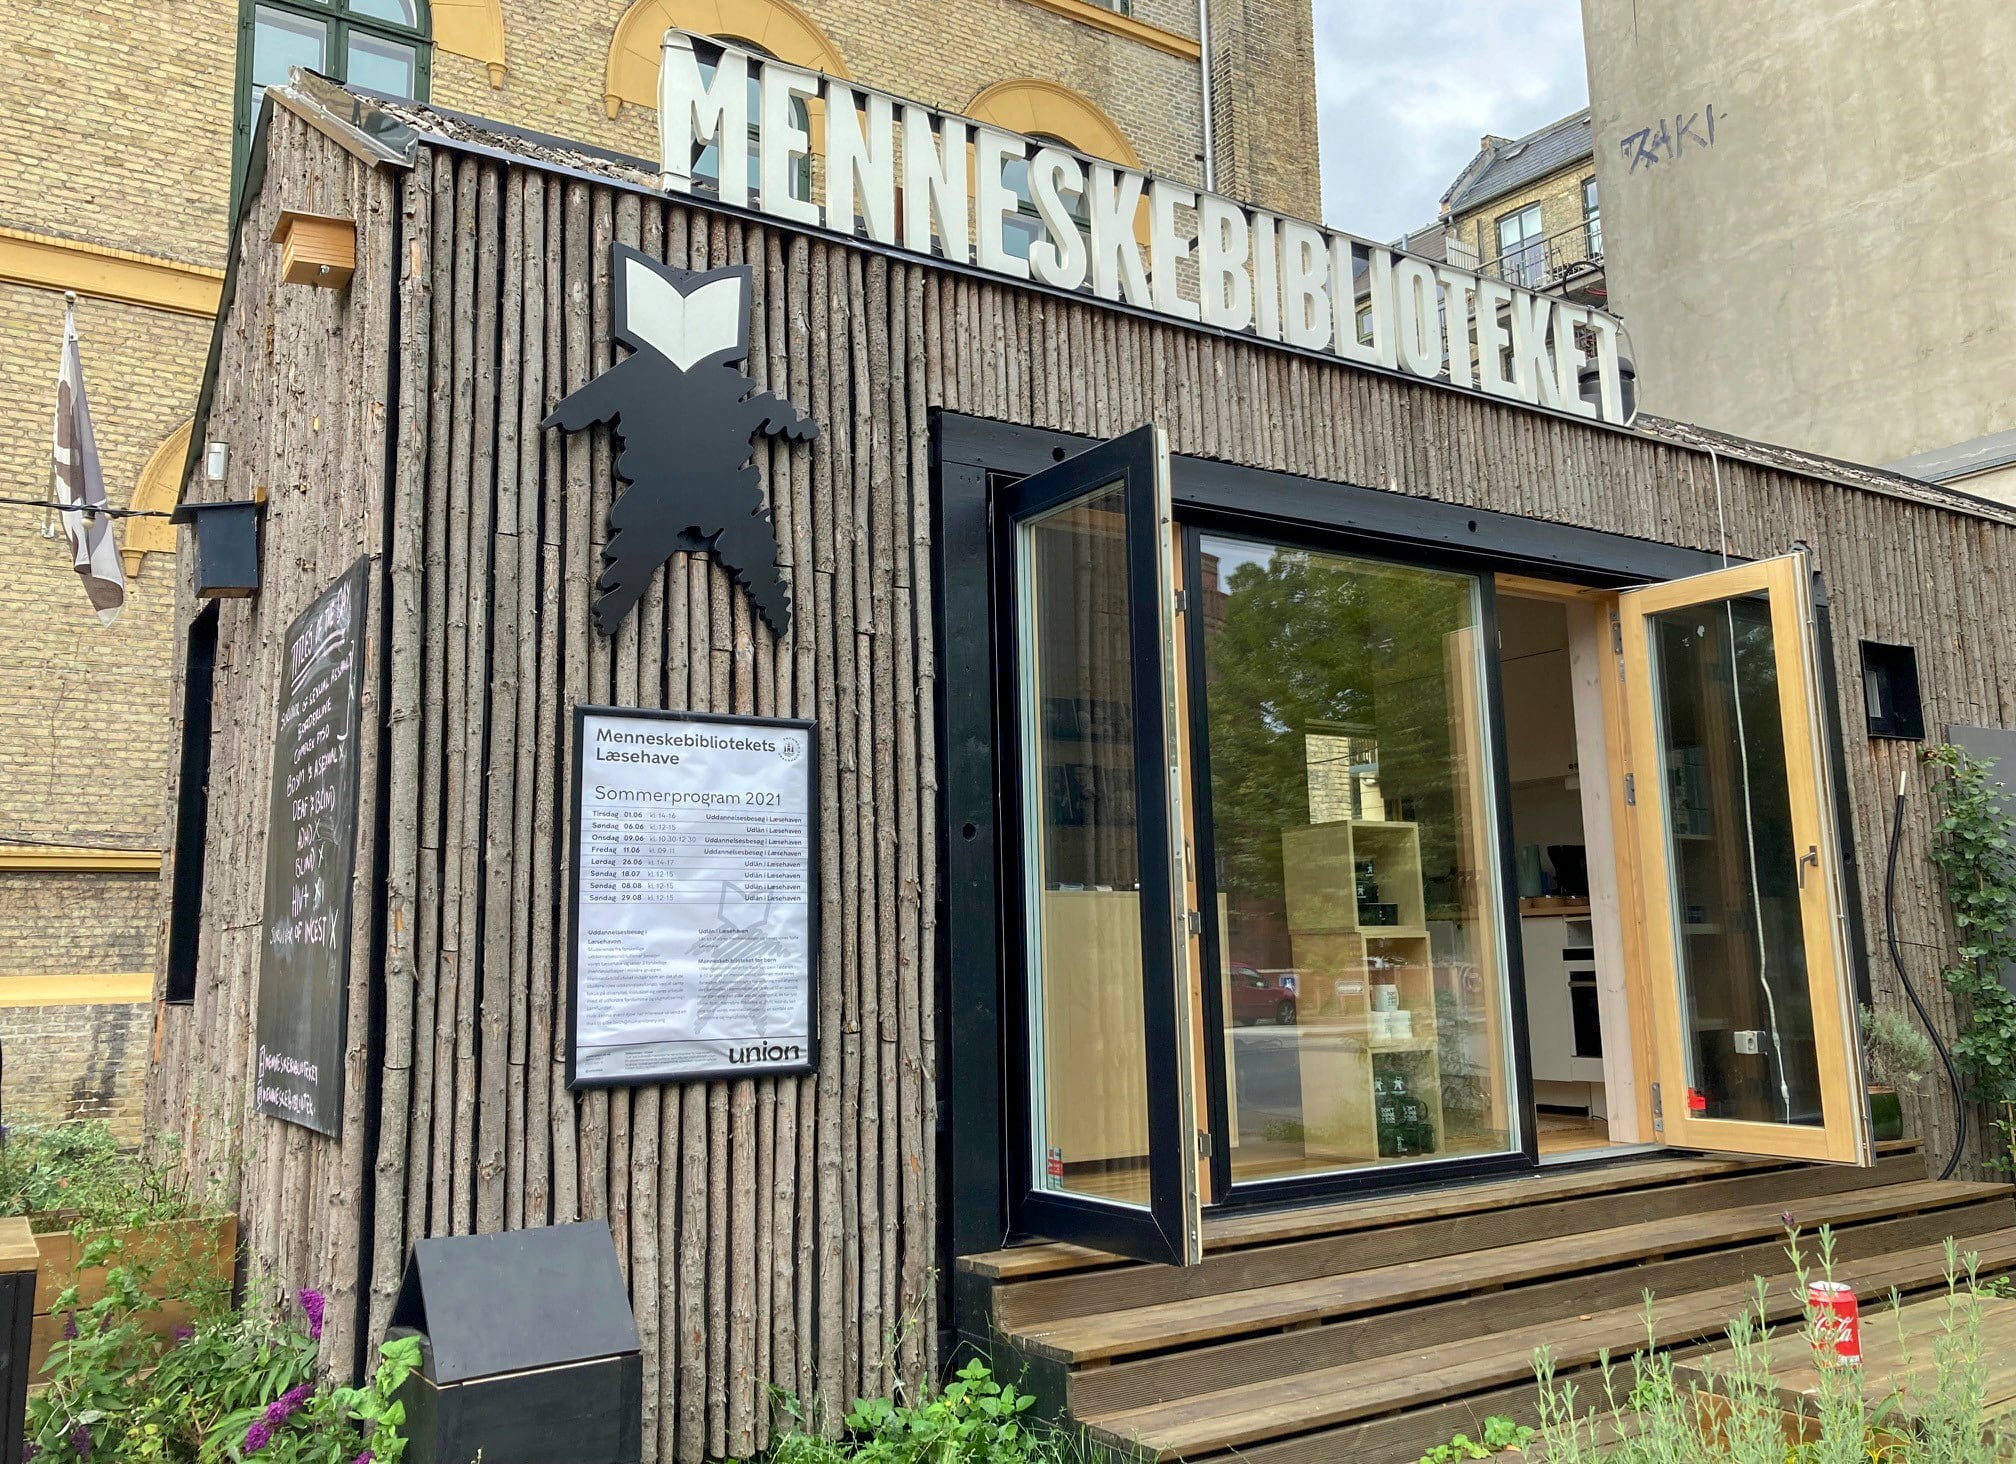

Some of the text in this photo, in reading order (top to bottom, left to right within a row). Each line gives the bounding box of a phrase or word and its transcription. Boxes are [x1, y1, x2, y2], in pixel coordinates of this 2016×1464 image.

[660, 30, 1626, 424] MENNESKEBIBLIOTEKET
[596, 728, 776, 752] Menneskebibliotekets
[596, 747, 680, 765] Læsehave
[293, 796, 308, 821] DEAF
[315, 785, 335, 814] BLIND
[595, 785, 781, 807] Sommerprogram 2021
[592, 810, 619, 819] Tirsdag
[592, 822, 619, 830] Søndag
[591, 834, 620, 842] Onsdag
[591, 858, 616, 866] Lørdag
[590, 870, 617, 878] Søndag
[729, 1040, 800, 1064] union
